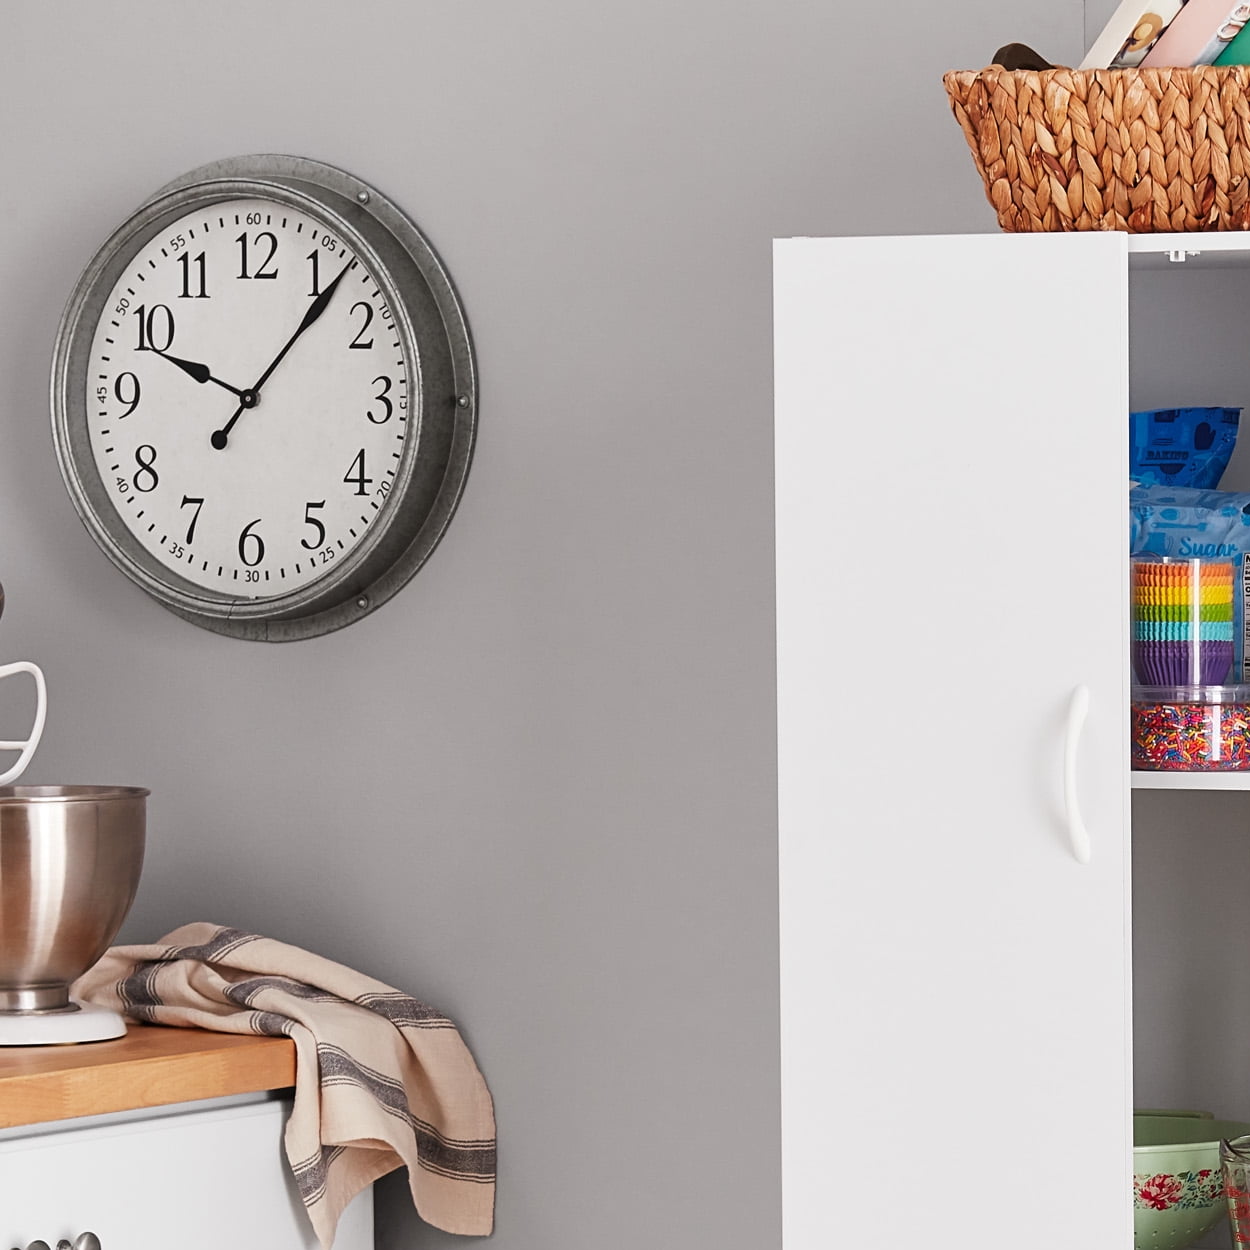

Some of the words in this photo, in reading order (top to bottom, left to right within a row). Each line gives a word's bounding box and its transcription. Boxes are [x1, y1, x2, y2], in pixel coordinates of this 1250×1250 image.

[169, 234, 187, 252] 55
[246, 213, 262, 225] 60
[235, 231, 280, 280] 12
[321, 235, 338, 252] 05
[176, 251, 212, 299] 11
[306, 249, 321, 297] 1
[115, 298, 131, 317] 50
[132, 304, 176, 352] 10
[348, 301, 375, 350] 2
[97, 386, 108, 404] 45
[114, 372, 141, 420] 9
[366, 375, 394, 425] 3
[116, 476, 130, 494] 40
[132, 444, 159, 493] 8
[343, 448, 374, 497] 4
[376, 480, 392, 500] 20
[180, 494, 206, 546] 7
[238, 518, 266, 567] 6
[300, 499, 327, 551] 5
[168, 542, 185, 559] 35
[318, 546, 335, 564] 25
[1178, 536, 1239, 558] Sugar
[244, 570, 261, 583] 30
